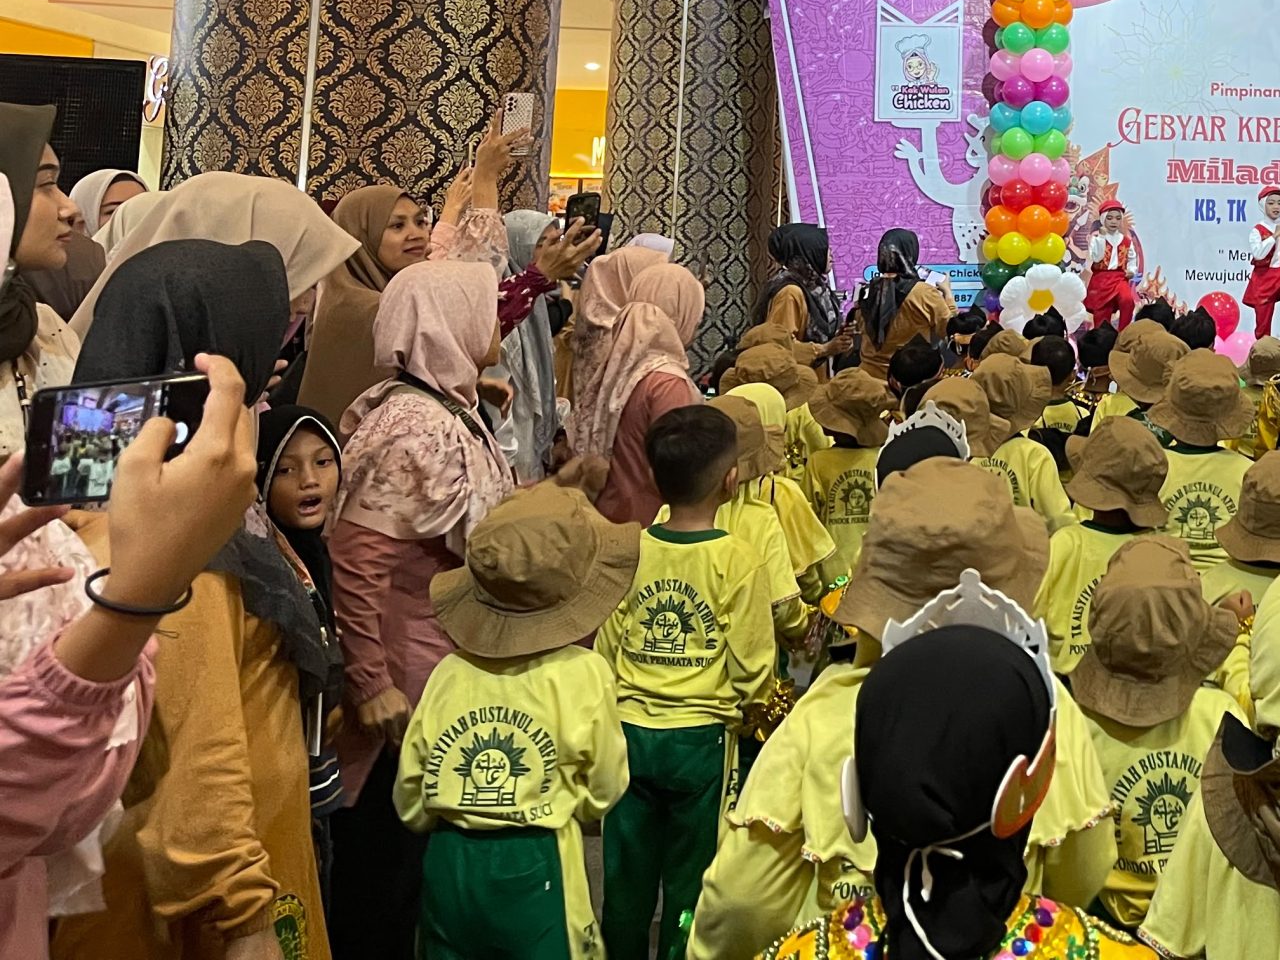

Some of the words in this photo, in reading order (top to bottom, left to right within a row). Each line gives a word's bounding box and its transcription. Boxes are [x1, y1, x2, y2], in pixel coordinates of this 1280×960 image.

[893, 92, 951, 110] Chicken
[1107, 107, 1226, 148] GEBYAR
[1194, 199, 1221, 224] KB,
[1227, 200, 1247, 222] TK
[1185, 269, 1251, 284] Mewujudk
[469, 706, 533, 734] BUSTANUL
[1139, 751, 1202, 779] BUSTANUL
